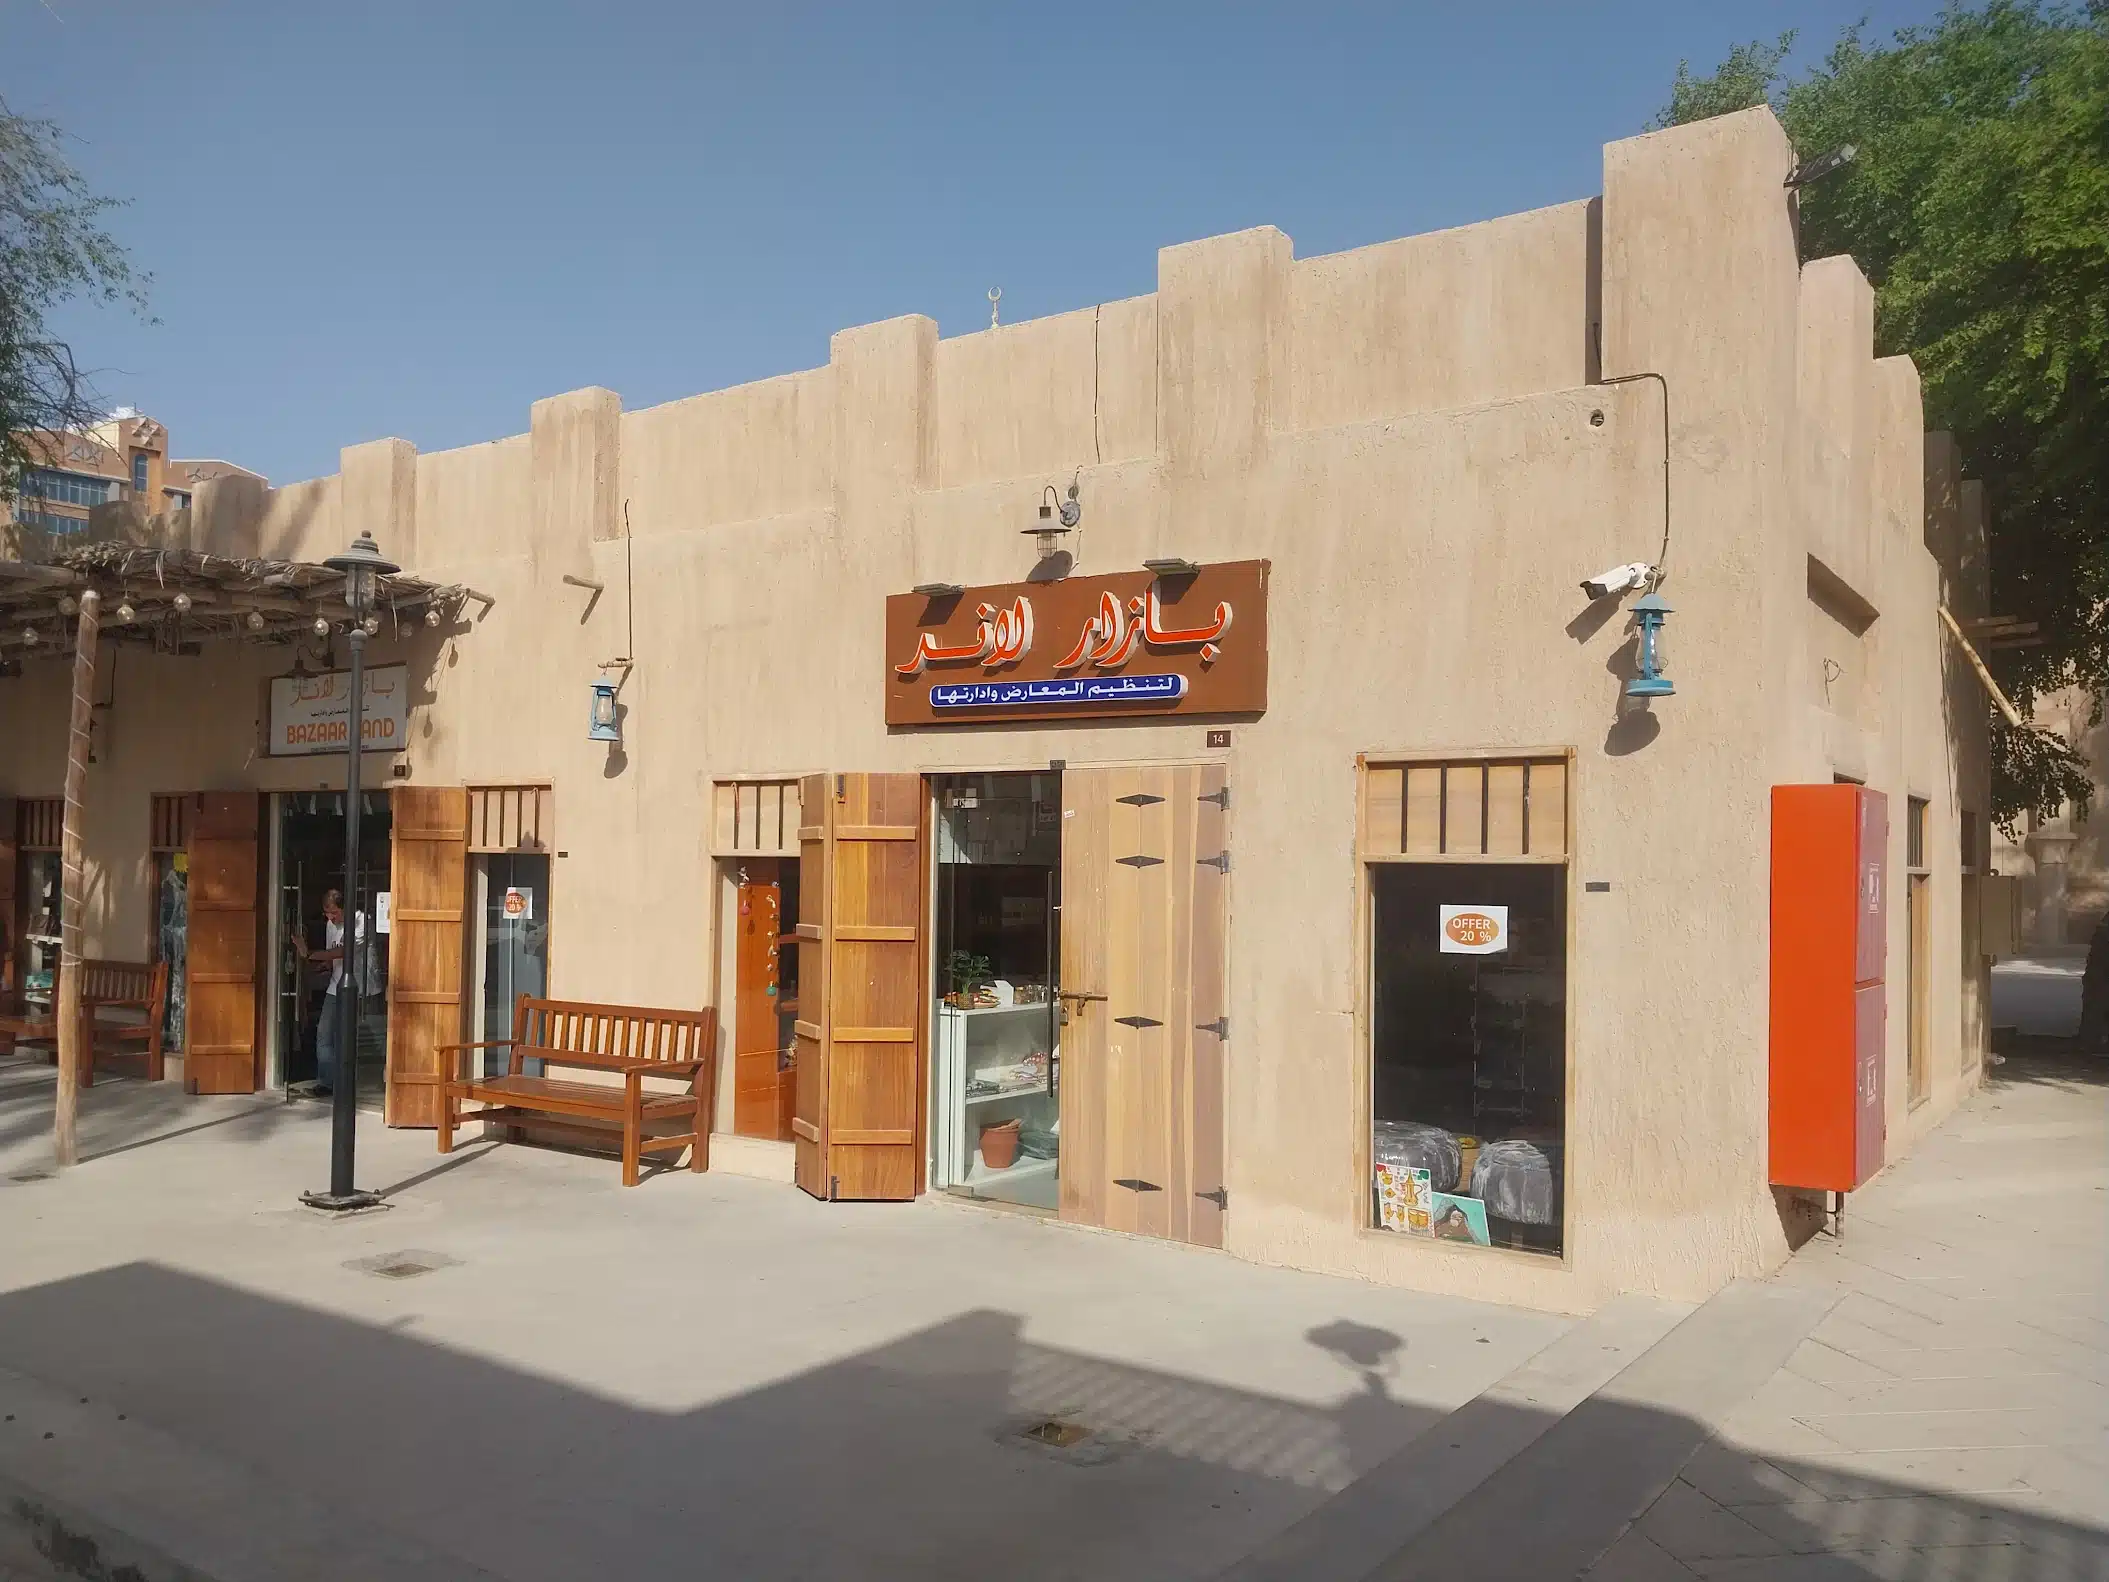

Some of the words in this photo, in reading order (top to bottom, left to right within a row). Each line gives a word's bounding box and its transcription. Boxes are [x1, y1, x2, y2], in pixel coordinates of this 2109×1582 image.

[895, 596, 1034, 674] لاند
[1053, 583, 1233, 669] بازار
[936, 684, 998, 704] وادارتها
[1001, 680, 1083, 702] المعارض
[1087, 674, 1173, 697] لتنظيم
[286, 720, 347, 745] BAZAAR
[361, 717, 395, 740] AND
[1213, 734, 1223, 744] 14
[1452, 917, 1491, 930] OFFER
[1460, 930, 1475, 941] 20
[1479, 930, 1492, 942] %
